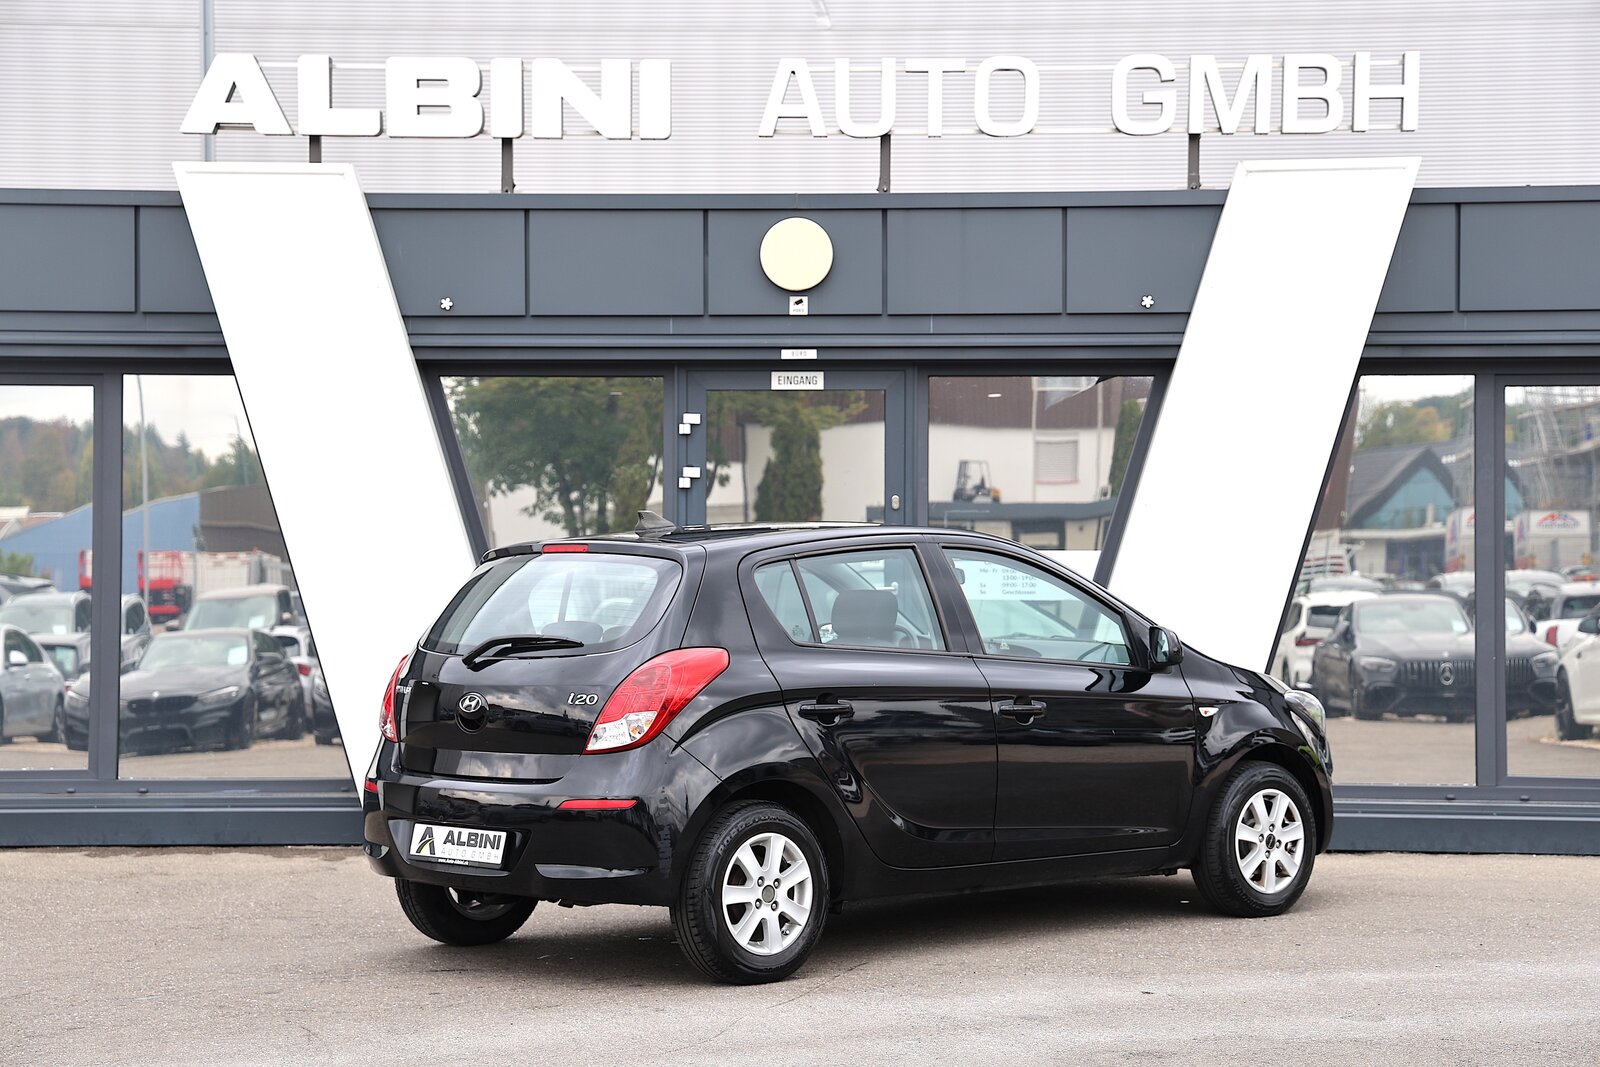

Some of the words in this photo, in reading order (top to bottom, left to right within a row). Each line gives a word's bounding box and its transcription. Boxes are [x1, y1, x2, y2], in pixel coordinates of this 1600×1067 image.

[179, 53, 672, 140] ALBINI
[758, 55, 1041, 138] AUTO
[1110, 51, 1421, 135] GMBH
[777, 375, 818, 385] EINGANG
[442, 829, 502, 850] ALBINI
[441, 847, 467, 858] AUTO
[470, 850, 499, 861] GMBH
